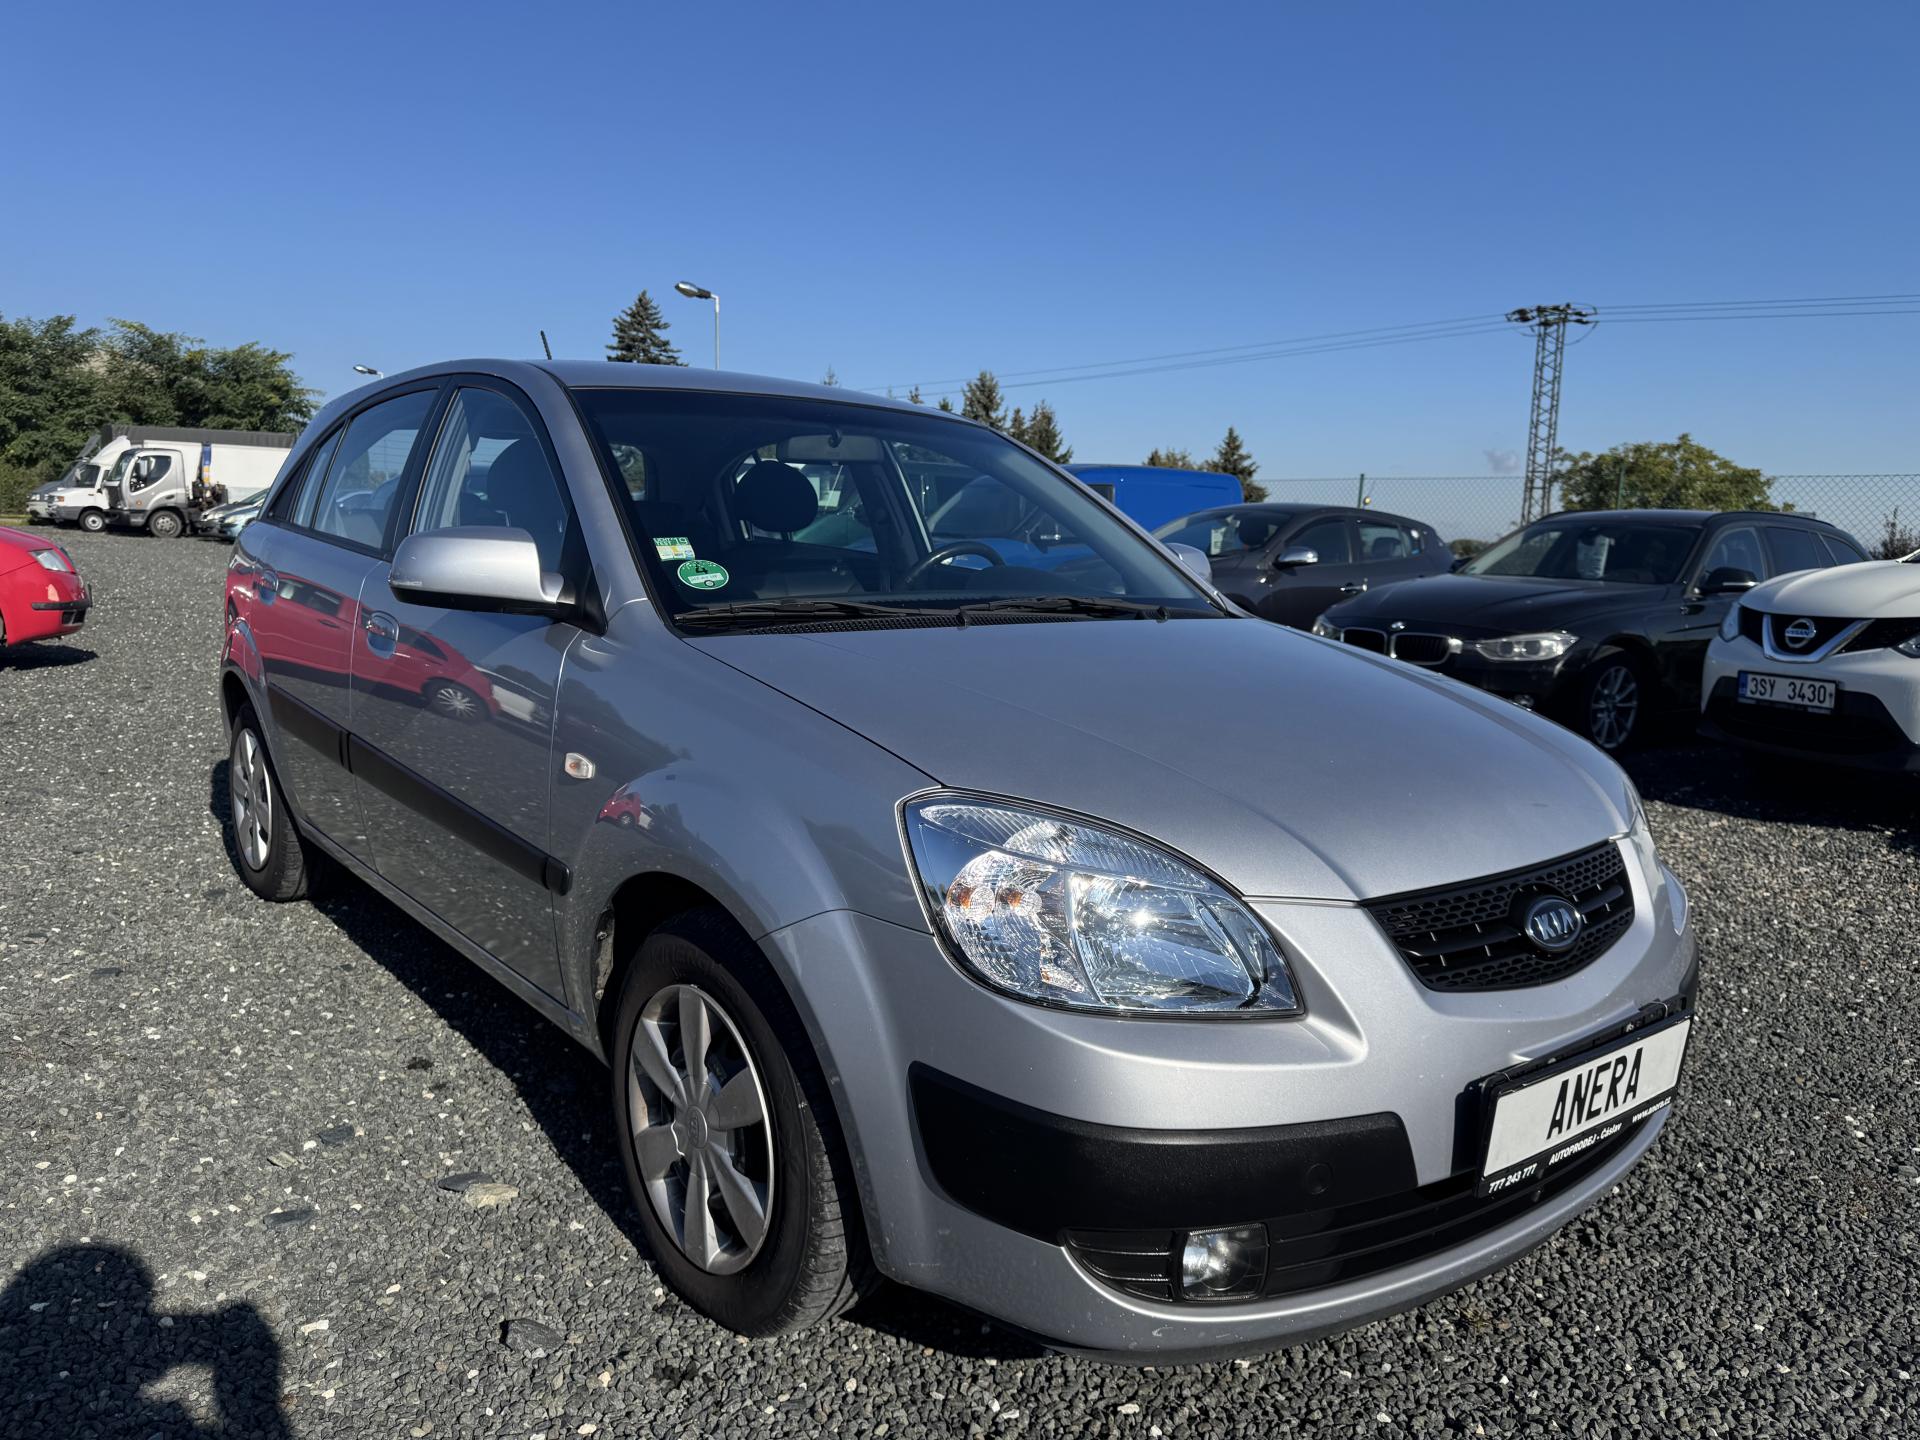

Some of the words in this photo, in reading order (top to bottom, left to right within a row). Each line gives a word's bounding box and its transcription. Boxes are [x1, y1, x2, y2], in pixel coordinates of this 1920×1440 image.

[695, 562, 708, 574] 4
[1750, 677, 1776, 697] 3SY
[1788, 682, 1827, 703] 3430
[1533, 907, 1575, 940] KIA
[1546, 1047, 1643, 1140] ANERA
[1488, 1177, 1506, 1193] 777
[1506, 1170, 1522, 1187] 243
[1523, 1163, 1538, 1179] 777
[1548, 1134, 1597, 1166] AUTOPRODEJ
[1632, 1096, 1672, 1123] www.anera.cz
